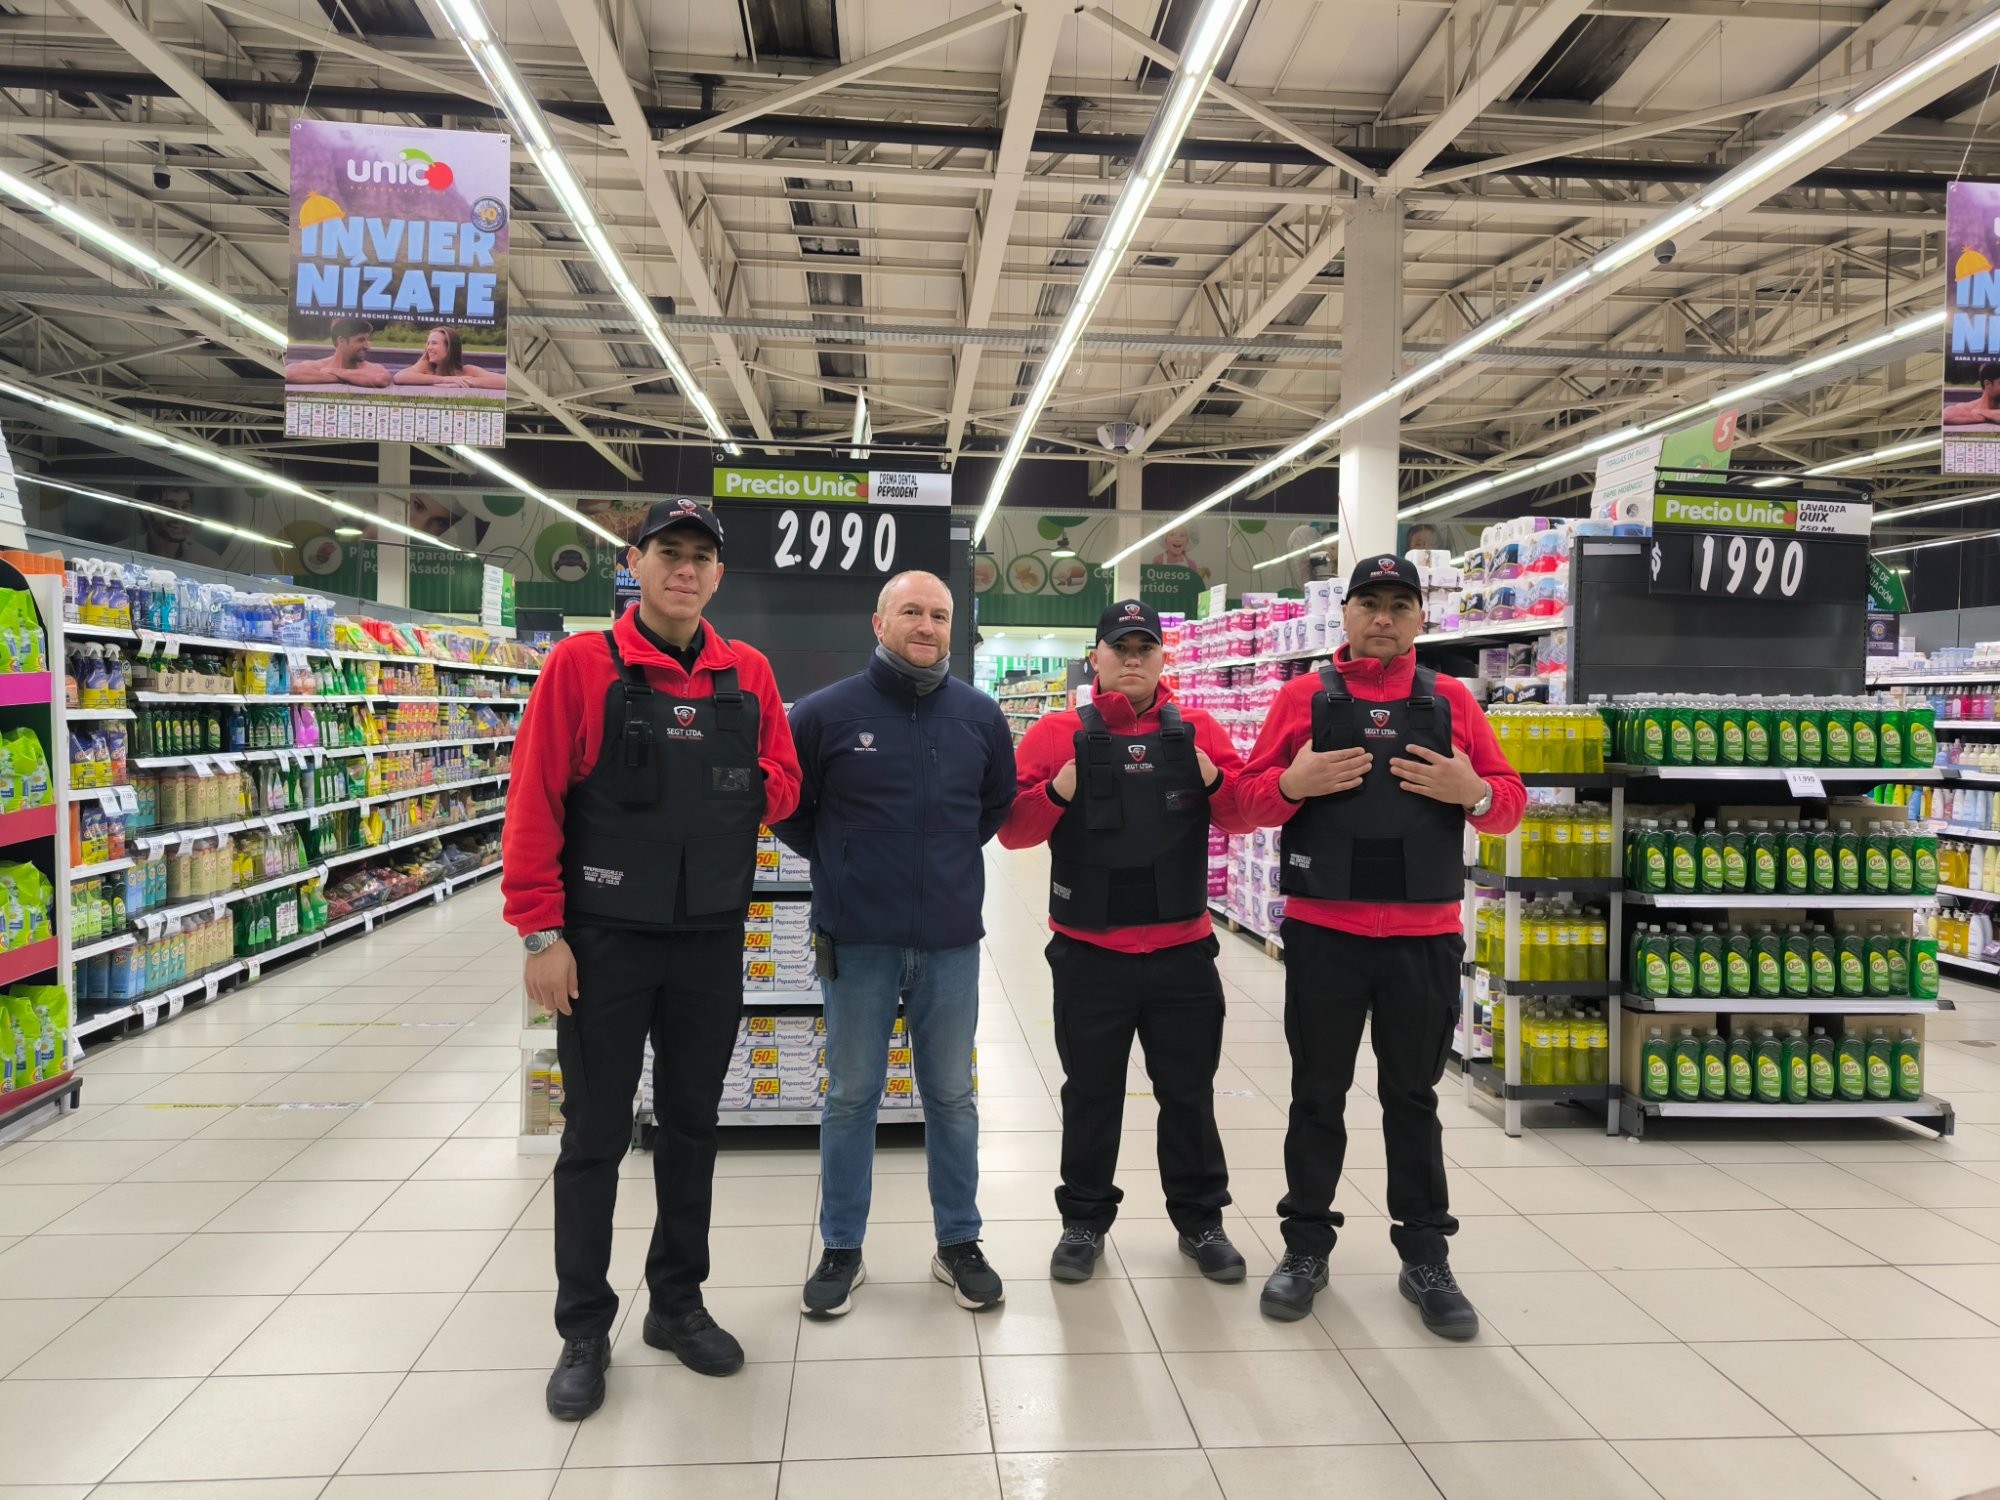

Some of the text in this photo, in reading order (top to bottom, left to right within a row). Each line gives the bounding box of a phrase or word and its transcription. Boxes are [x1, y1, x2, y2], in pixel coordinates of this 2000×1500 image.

[301, 216, 496, 266] INVIER
[726, 473, 800, 495] Precio
[879, 472, 917, 486] CREMA DENTAL
[877, 486, 918, 498] PEPSODENT
[1665, 500, 1733, 522] Precio
[1800, 503, 1846, 514] LAVALOZA
[1800, 512, 1828, 524] QUIX
[409, 563, 456, 575] Asados
[1700, 535, 1804, 596] 1990
[1146, 568, 1190, 580] Quesos
[750, 904, 766, 916] 50
[747, 934, 764, 946] 50
[750, 963, 768, 974] 50
[750, 1018, 768, 1030] 50
[754, 1050, 770, 1062] 50
[888, 1050, 904, 1062] 50
[755, 1080, 772, 1092] 50
[888, 1080, 905, 1091] 50
